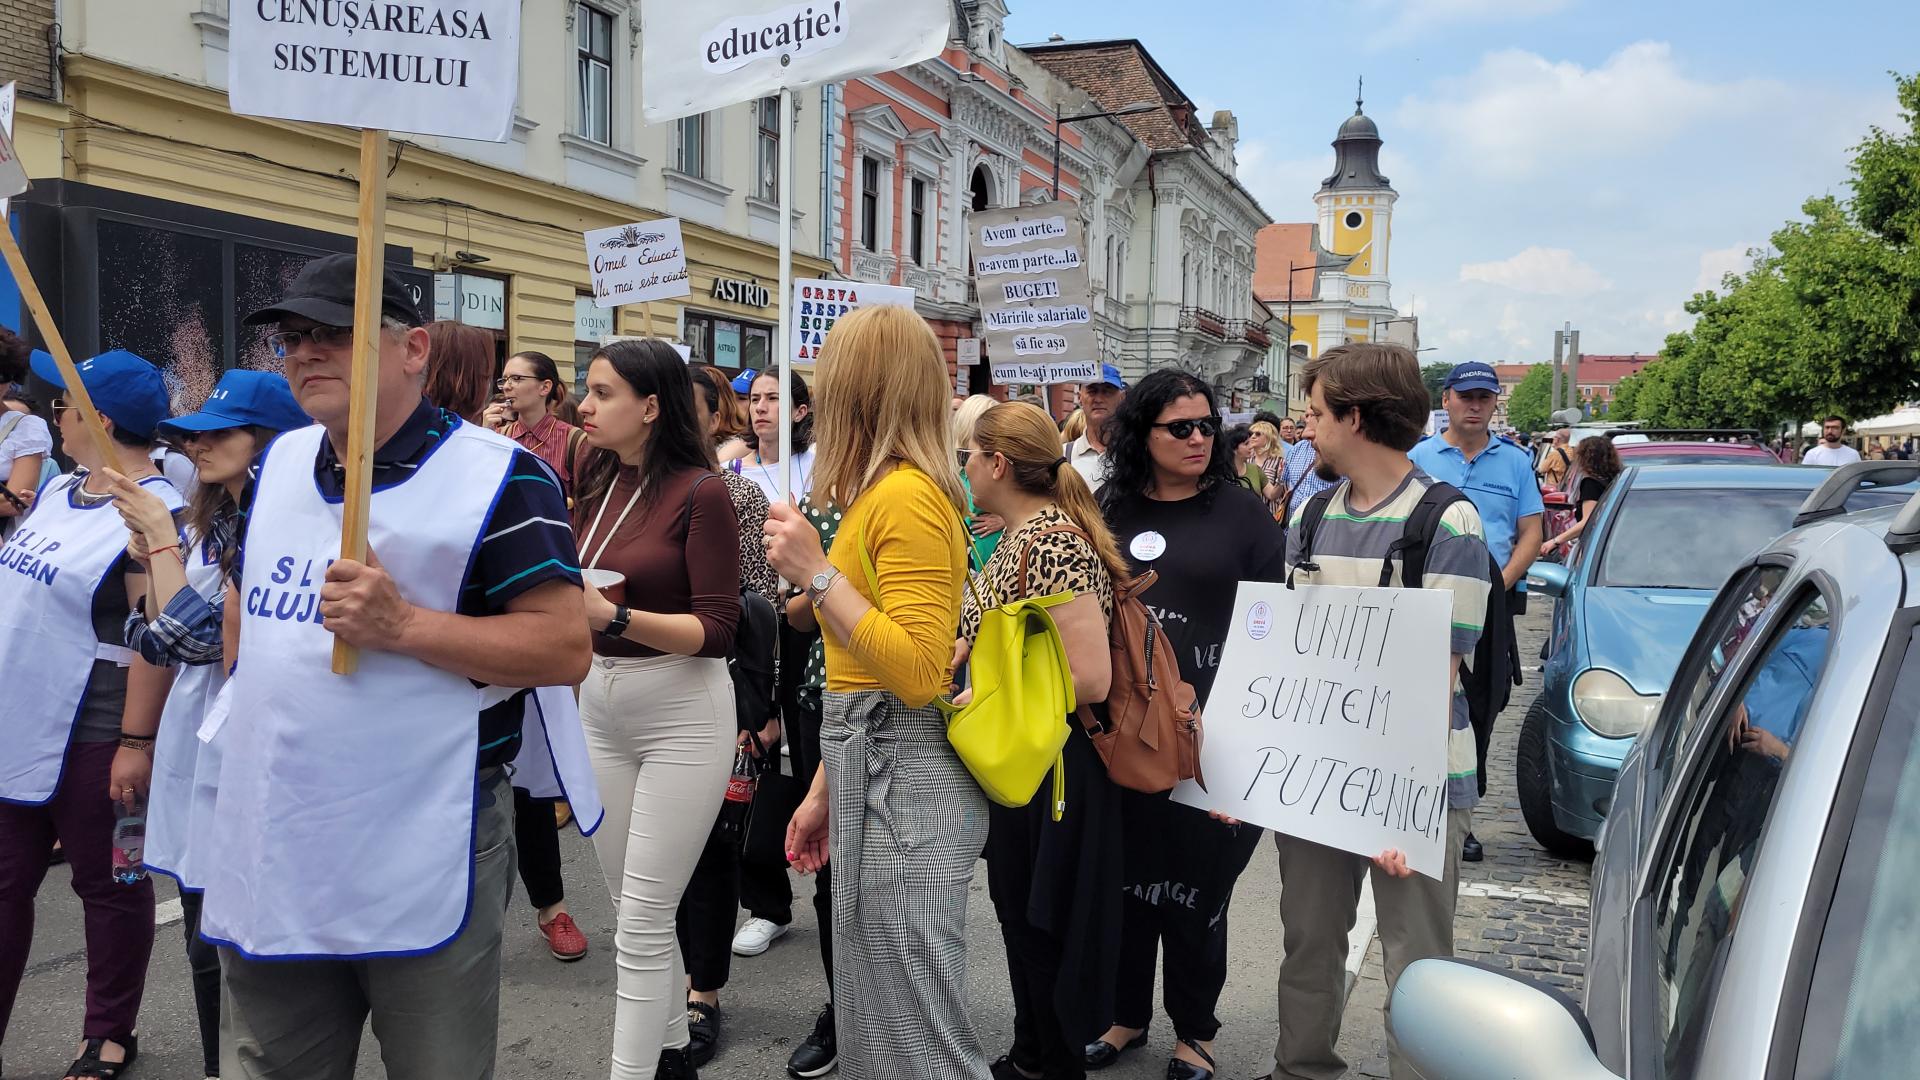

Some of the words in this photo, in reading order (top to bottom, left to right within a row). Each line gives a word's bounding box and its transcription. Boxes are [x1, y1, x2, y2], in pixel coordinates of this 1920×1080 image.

[274, 43, 471, 87] SISTEMULUI
[984, 228, 1016, 242] Avem
[1022, 221, 1064, 236] carte...
[594, 254, 628, 274] Omul
[638, 246, 680, 266] Educat
[978, 257, 1019, 272] n-avem
[595, 278, 610, 298] Nu
[614, 280, 634, 294] mai
[639, 272, 659, 290] este
[802, 286, 858, 302] GREVA
[1004, 281, 1058, 299] BUGET!
[581, 317, 606, 329] ODIN
[990, 311, 1034, 326] Măririle
[1037, 307, 1088, 323] salariale
[800, 330, 828, 345] VA
[1015, 338, 1027, 350] să
[1029, 337, 1044, 349] fie
[995, 368, 1017, 379] cum
[1050, 363, 1096, 380] promis!
[1195, 641, 1226, 669] VE
[1241, 676, 1391, 735] SUNTEM
